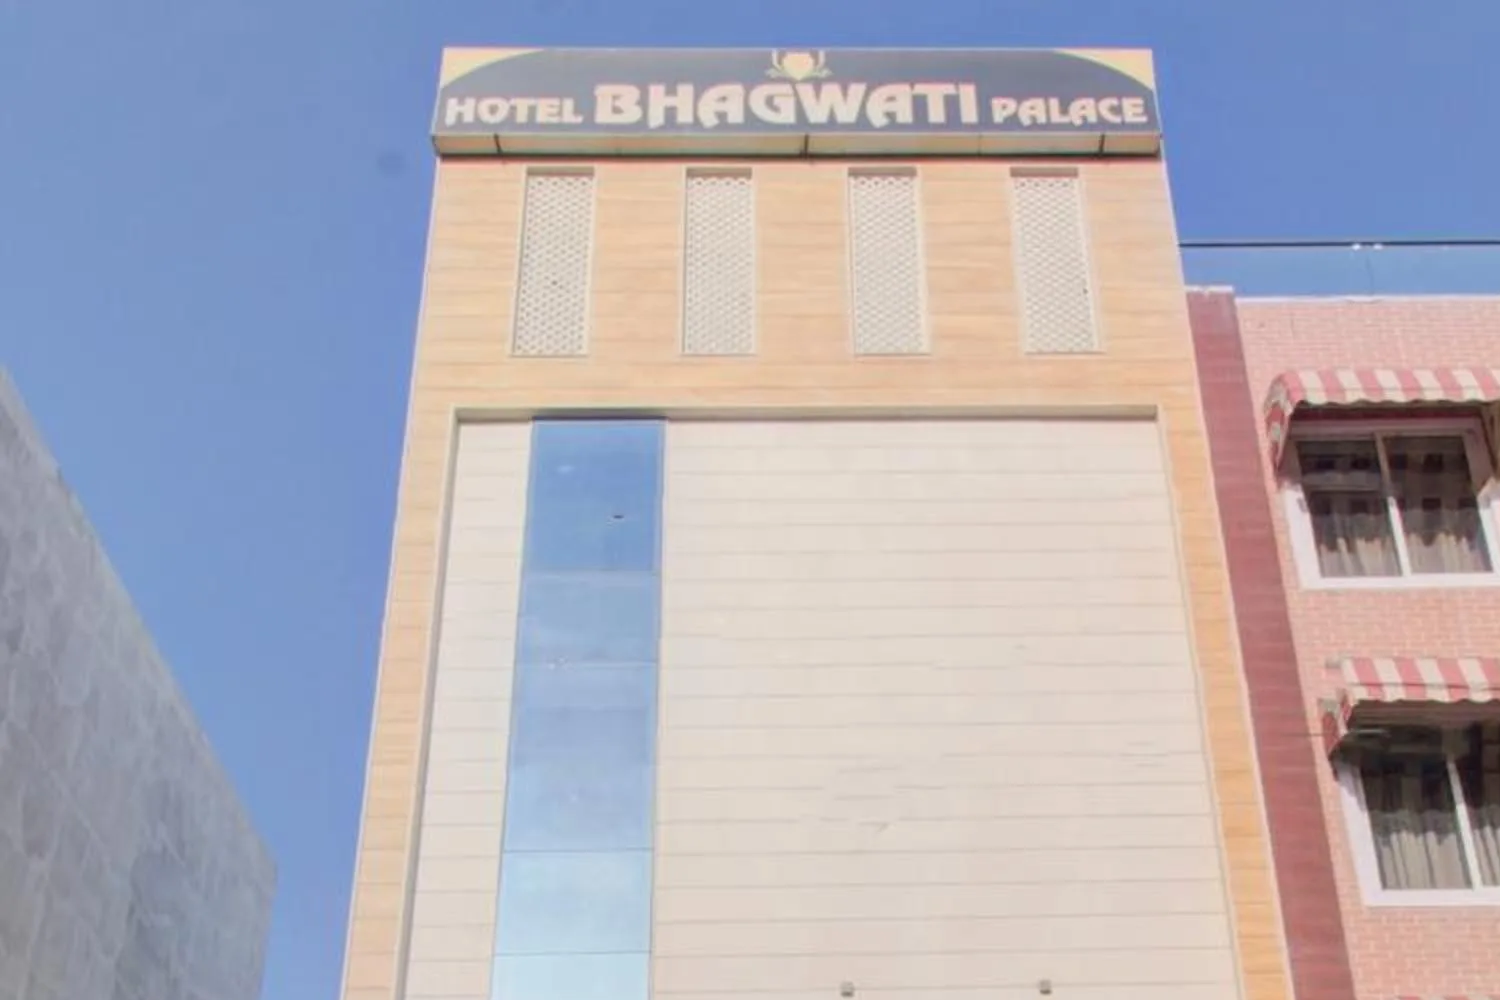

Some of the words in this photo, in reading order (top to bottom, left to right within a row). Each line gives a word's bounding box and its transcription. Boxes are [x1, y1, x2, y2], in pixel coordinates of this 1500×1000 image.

[445, 97, 584, 126] HOTEL
[593, 82, 979, 128] BHAGWATI
[991, 97, 1148, 126] PALACE
